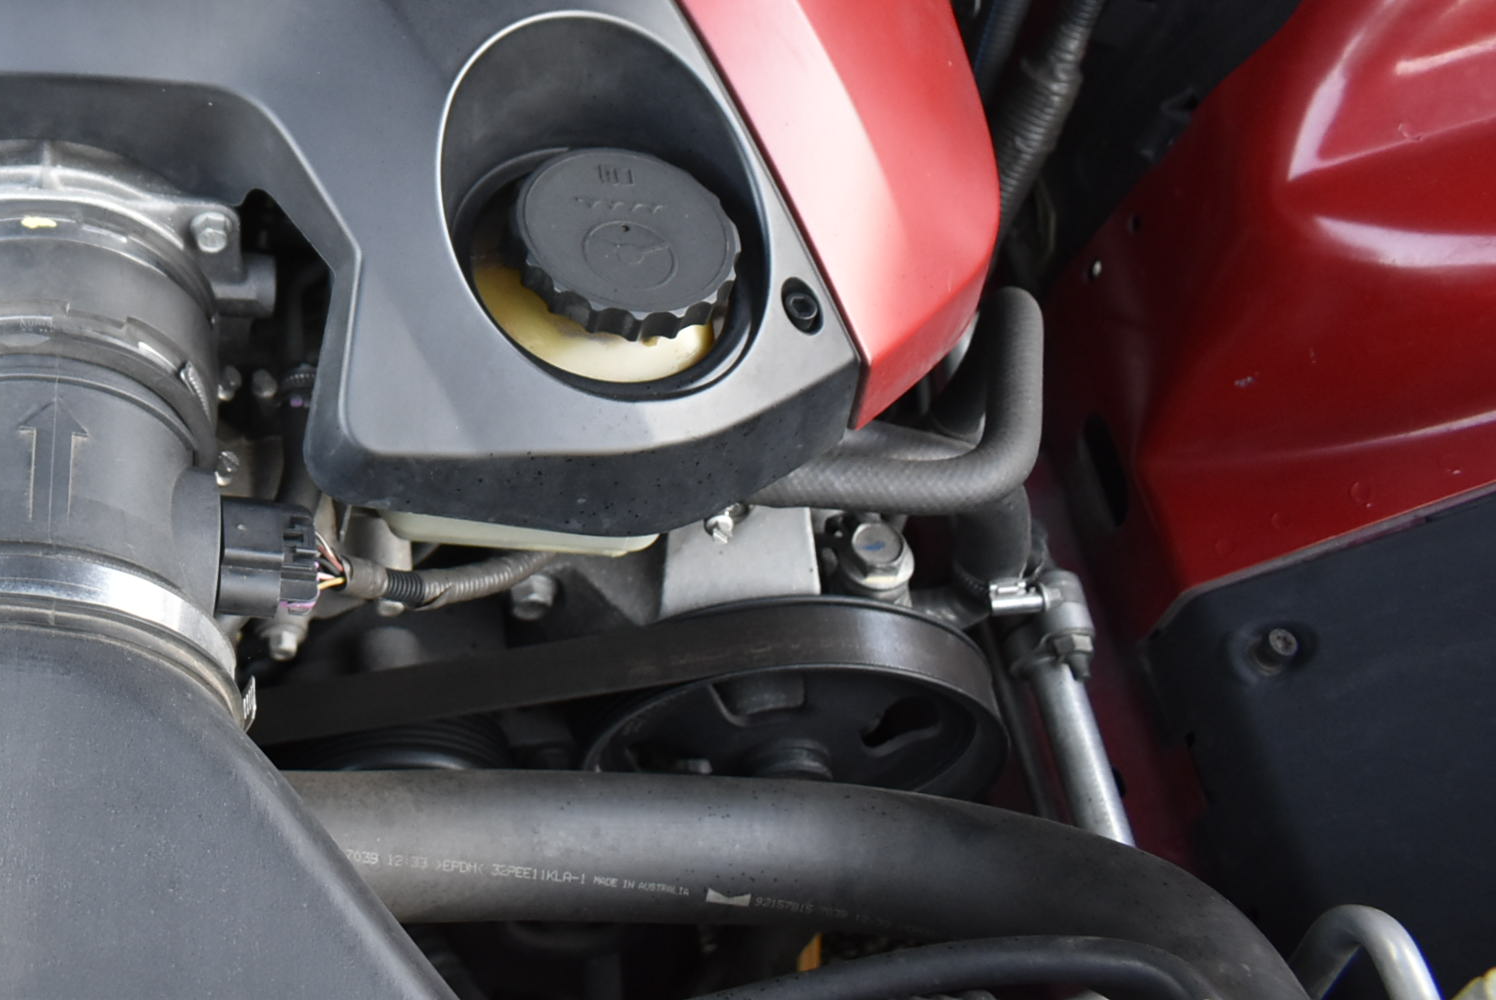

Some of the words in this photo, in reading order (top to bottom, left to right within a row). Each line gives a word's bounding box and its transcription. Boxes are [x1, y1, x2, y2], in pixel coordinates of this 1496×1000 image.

[593, 875, 617, 888] MADE
[623, 879, 635, 889] IN
[638, 881, 690, 897] AUSTRALIA
